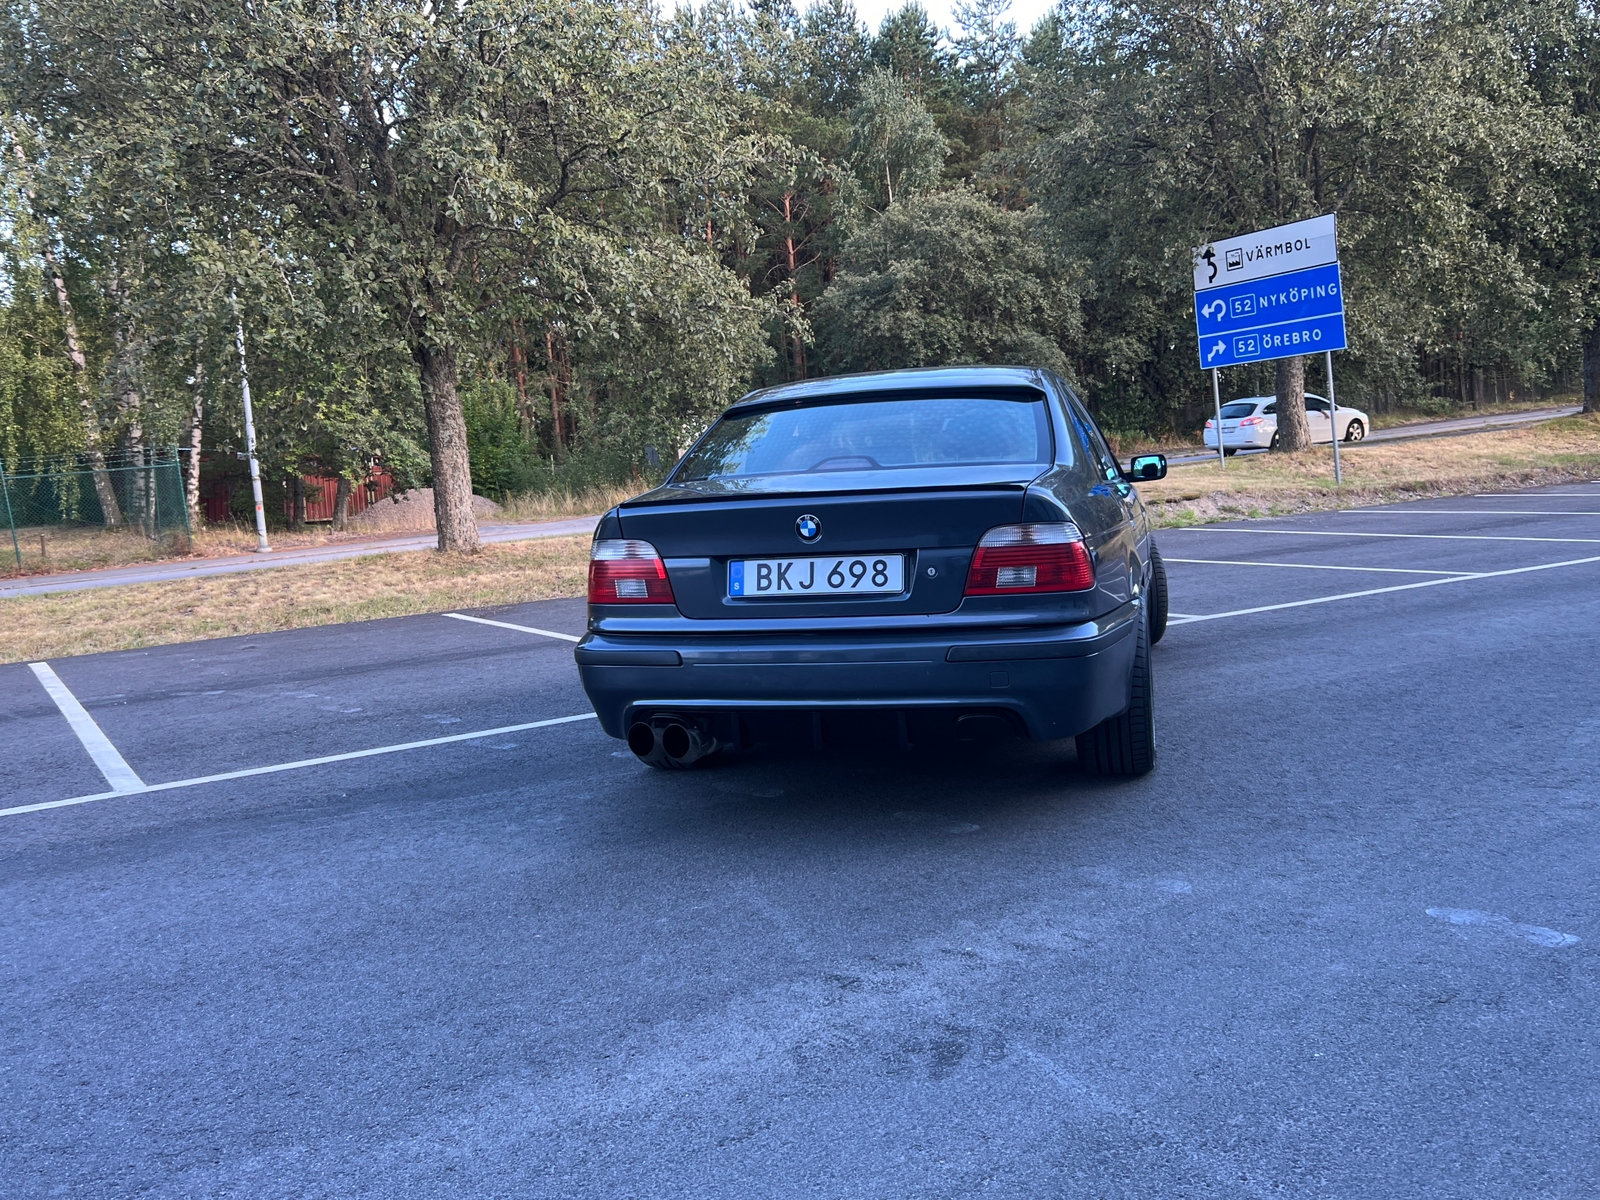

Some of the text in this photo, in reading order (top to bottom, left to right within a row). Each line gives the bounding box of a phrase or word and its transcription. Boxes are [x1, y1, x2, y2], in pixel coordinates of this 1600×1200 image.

[1246, 238, 1311, 262] VÄRMBOL
[1234, 283, 1337, 313] 52 NYKÖPING
[1238, 329, 1322, 353] 52 ÖREBRO
[733, 582, 740, 590] S
[756, 559, 889, 591] BKJ 698
